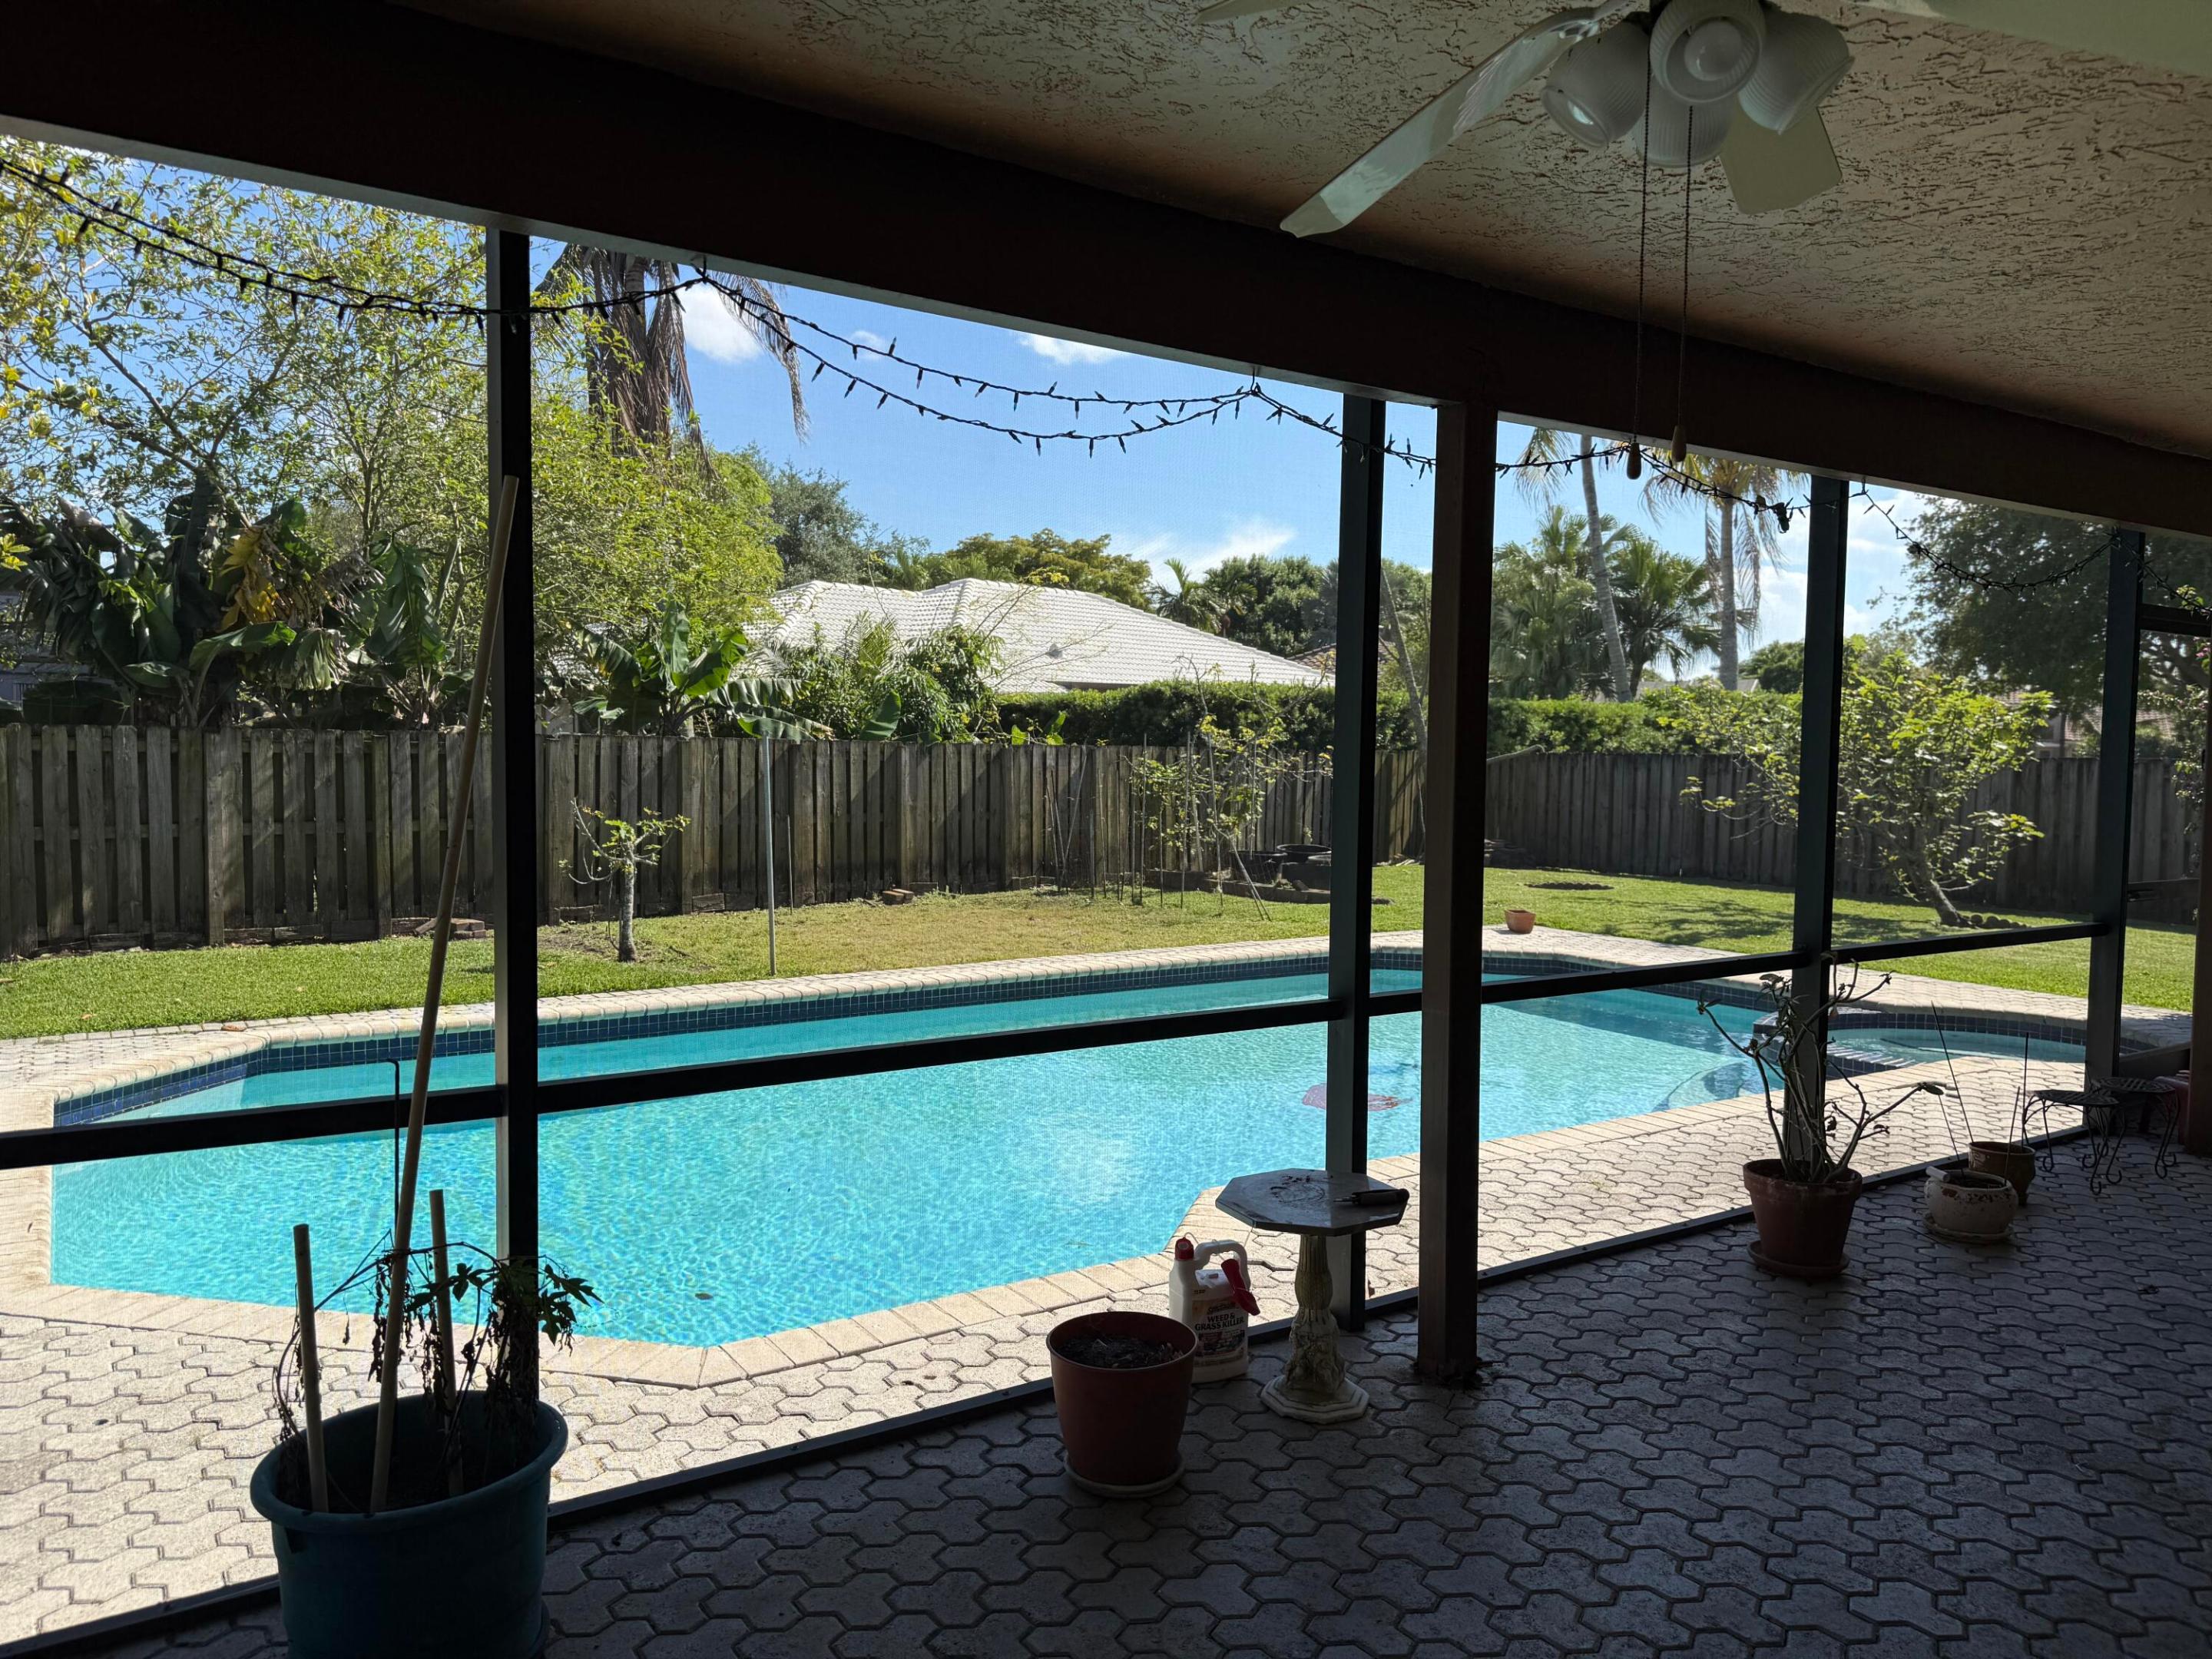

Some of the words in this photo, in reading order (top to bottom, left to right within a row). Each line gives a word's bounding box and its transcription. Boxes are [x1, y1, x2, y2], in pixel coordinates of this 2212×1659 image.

[1194, 1322, 1221, 1331] GRASS
[1222, 1316, 1244, 1328] KILLER
[1207, 1313, 1229, 1323] WEED
